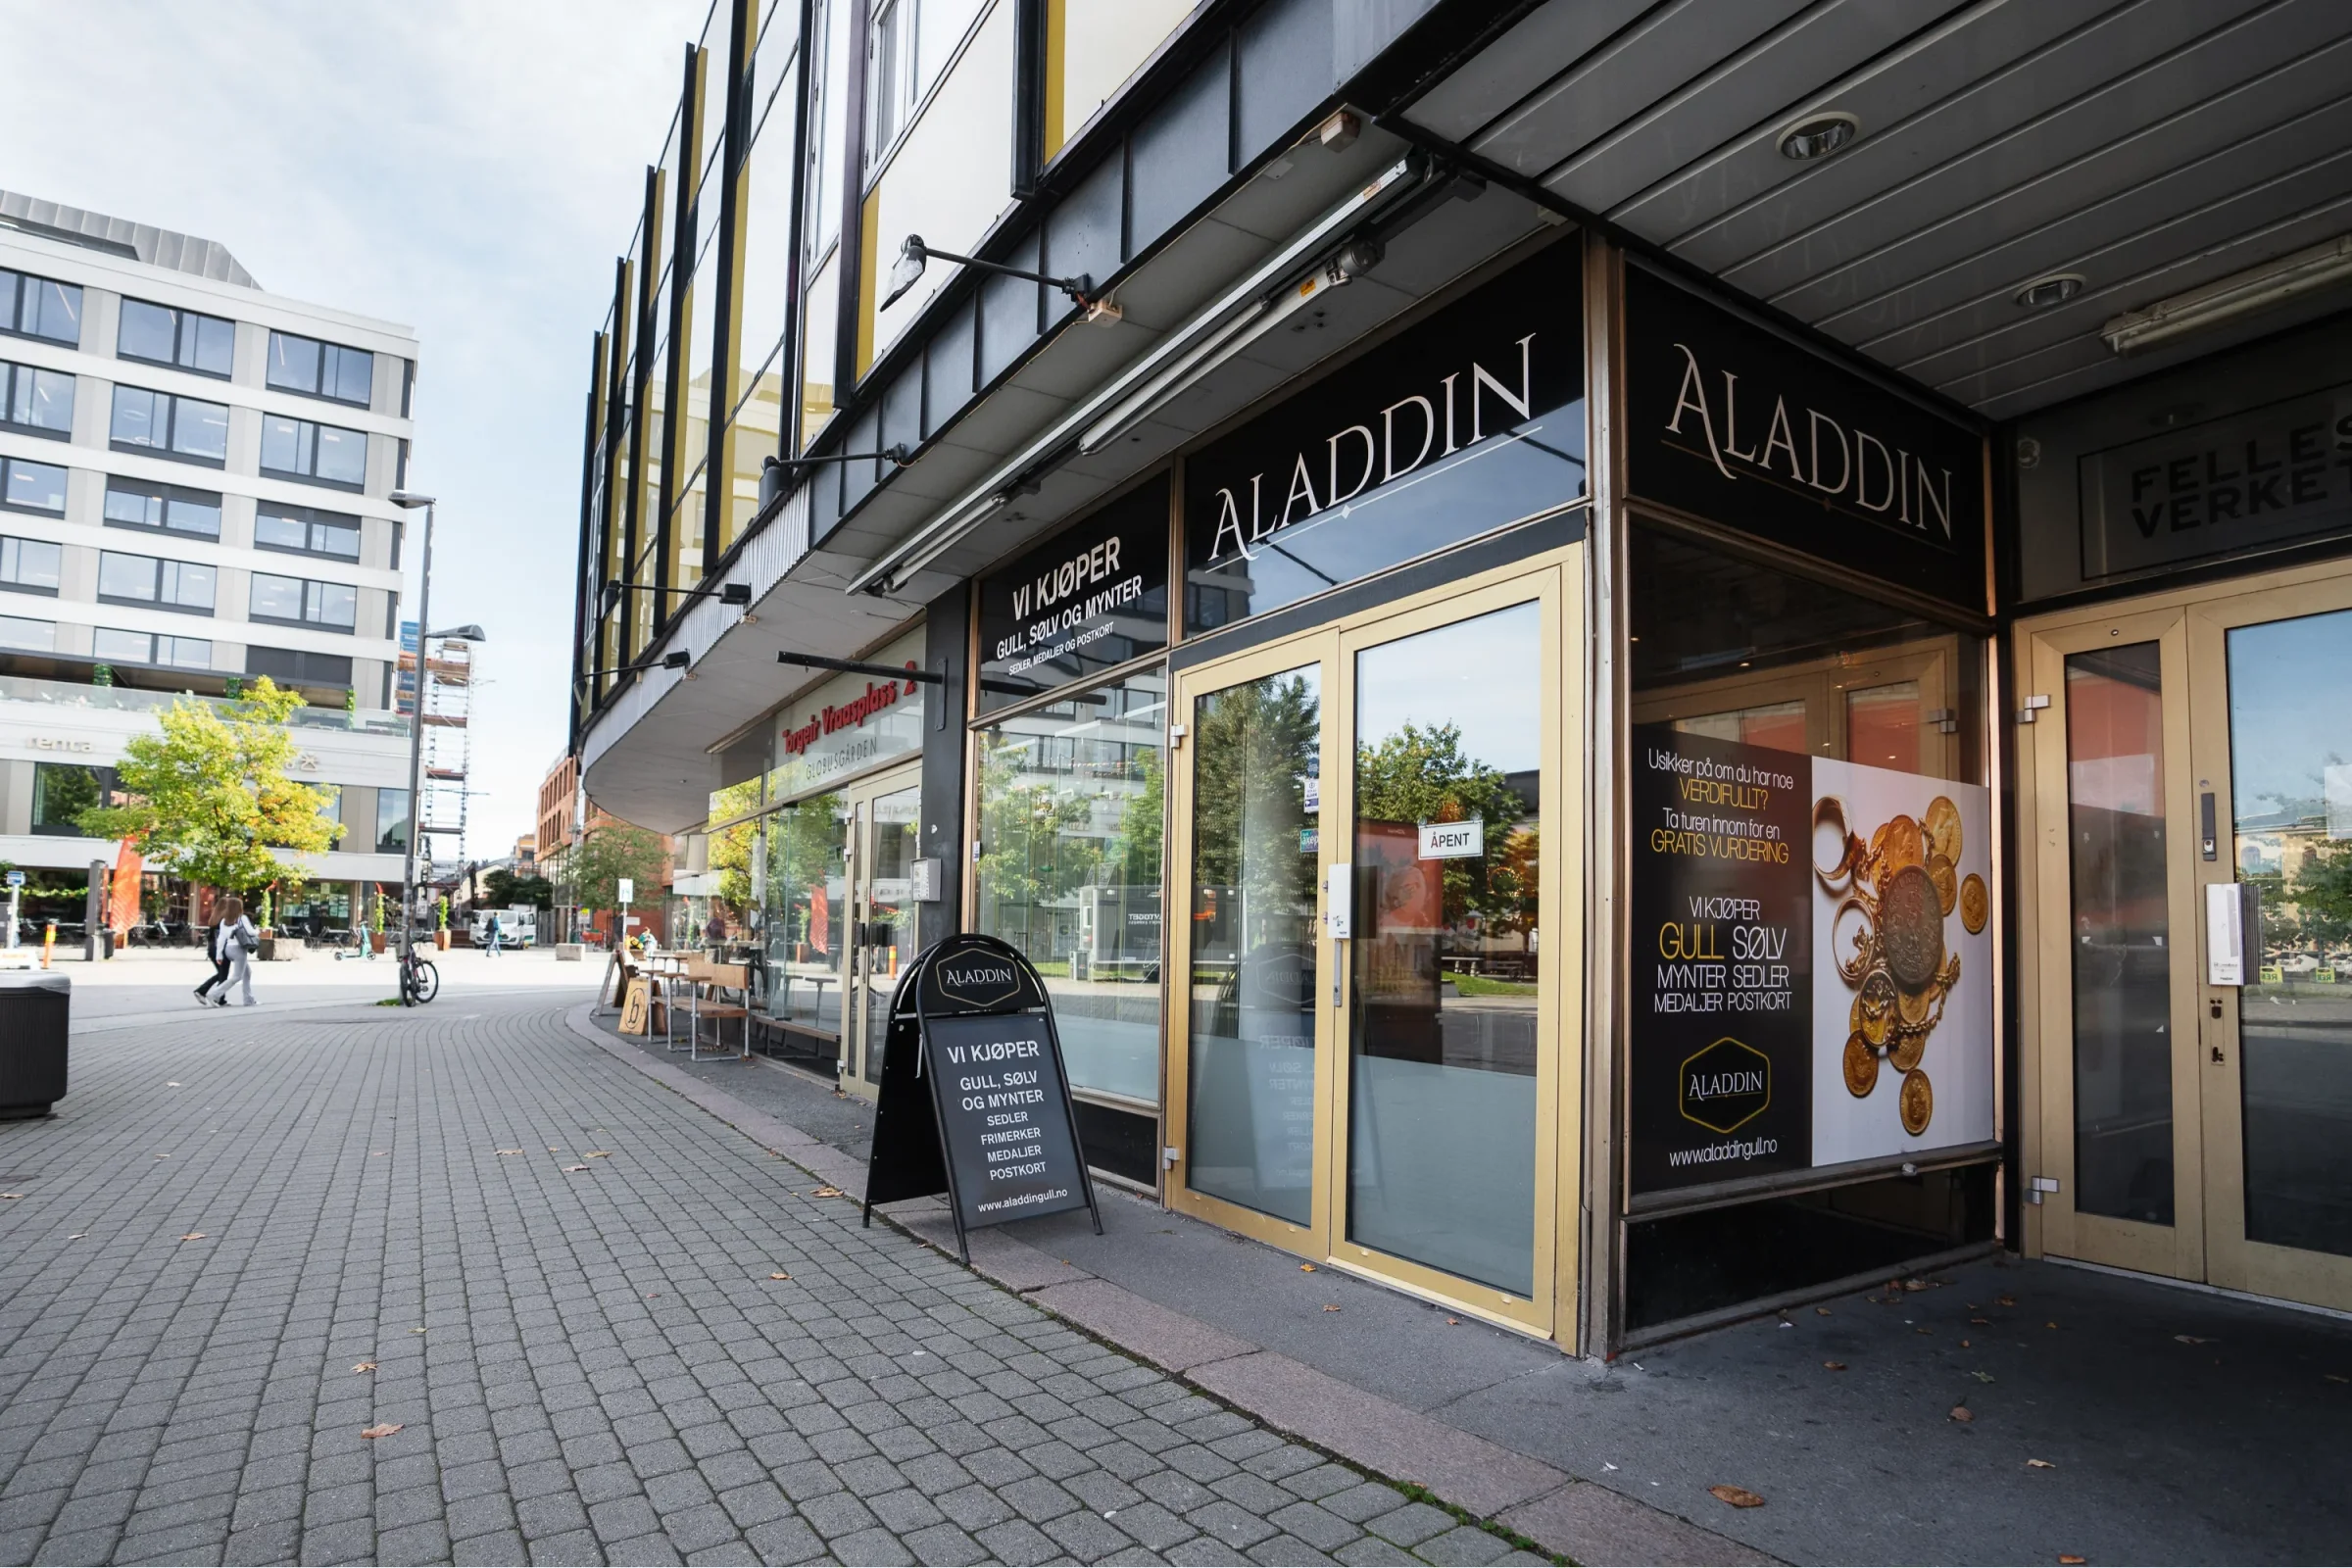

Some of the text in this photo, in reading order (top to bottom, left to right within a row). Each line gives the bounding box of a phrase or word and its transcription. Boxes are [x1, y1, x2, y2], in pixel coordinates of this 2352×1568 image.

[1208, 332, 1537, 563] ALADDIN
[1664, 343, 1953, 541] ALADDIN
[1012, 536, 1121, 621] VI KJØPER
[997, 575, 1143, 660] GULL, SØLV OG MYNTER
[1008, 621, 1114, 676] SEDLER, MEDALJER OG POSTKORT
[782, 714, 820, 755] Torgeir
[821, 680, 897, 735] Vraasplass
[806, 736, 877, 780] GLOBUSGÅRDEN
[1648, 748, 1793, 790] Usikker på om du har noe
[1679, 777, 1769, 810] VERDIFULLT?
[1662, 807, 1781, 840] Ta turen innom for en
[1301, 836, 1318, 849] axep
[1430, 831, 1470, 849] ÅPENT
[1651, 828, 1789, 864] GRATIS VURDERING
[1689, 896, 1760, 920] VI KJØPER
[1659, 921, 1788, 960] GULL SØLV
[946, 967, 1012, 987] ALADDIN
[1657, 964, 1789, 989] MYNTER SEDLER
[1654, 992, 1792, 1012] MEDALJER POSTKORT
[947, 1040, 1040, 1064] VI KJØPER
[959, 1070, 1038, 1091] GULL, SØLV
[1689, 1070, 1763, 1102] ALADDIN
[961, 1090, 1045, 1111] OG MYNTER
[987, 1111, 1029, 1126] SEDLER
[980, 1127, 1042, 1146] FRIMERKER
[987, 1145, 1042, 1163] MEDALJER
[1669, 1137, 1778, 1167] www.aladdingull.no
[989, 1161, 1047, 1181] POSTKORT
[977, 1188, 1068, 1213] www.aladdingull.no
